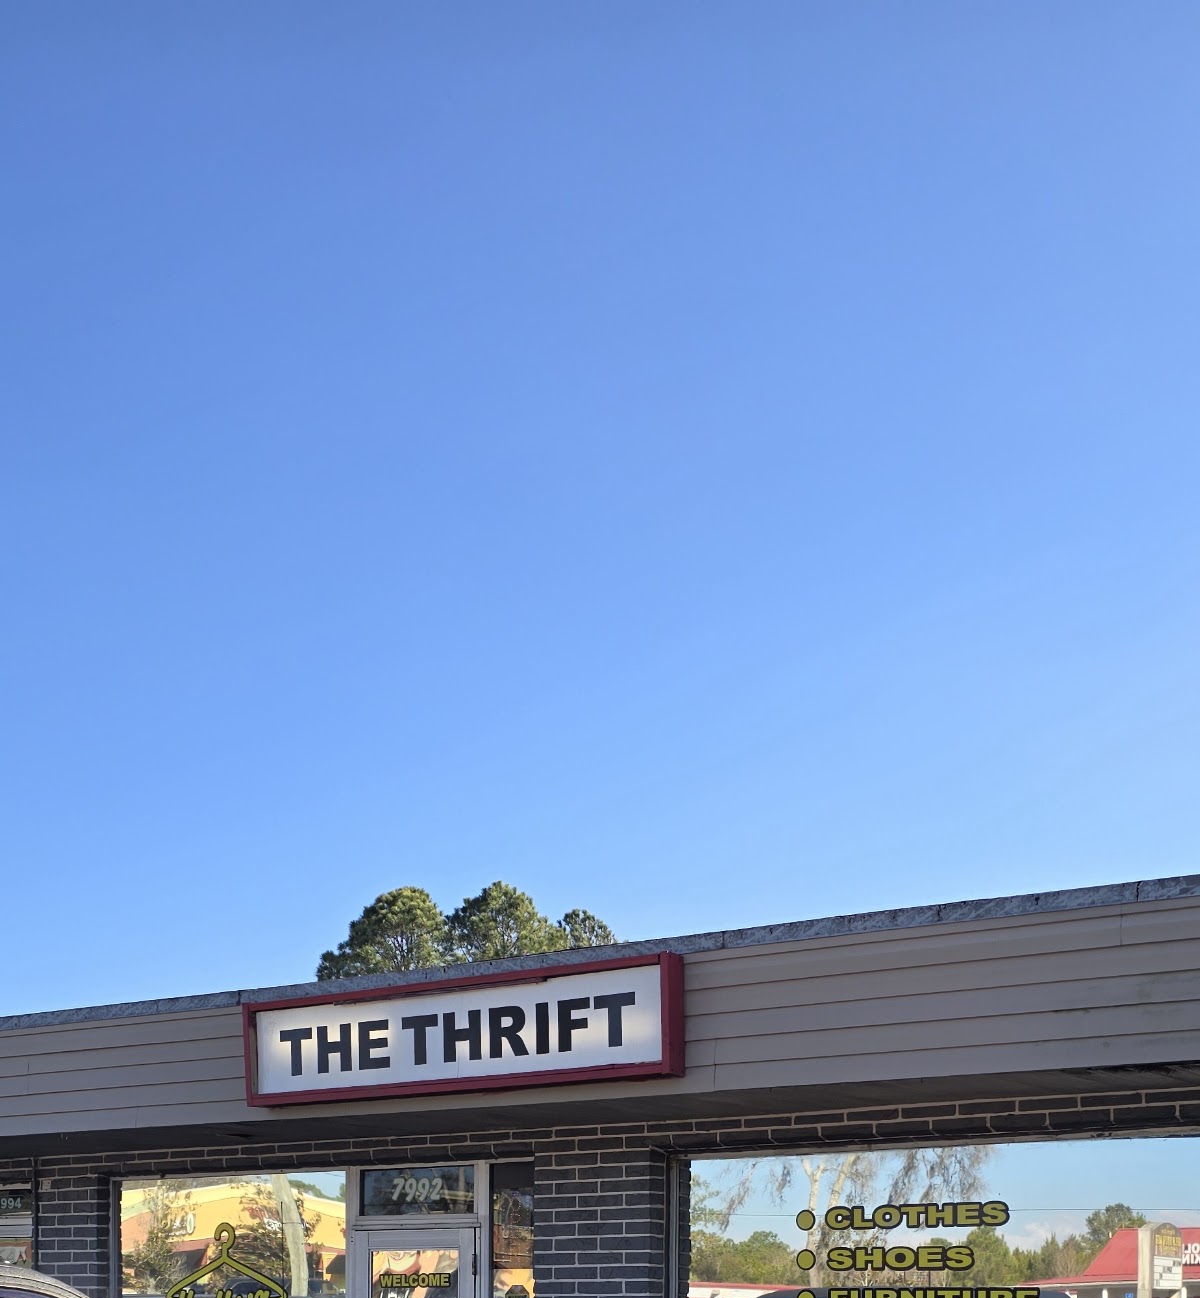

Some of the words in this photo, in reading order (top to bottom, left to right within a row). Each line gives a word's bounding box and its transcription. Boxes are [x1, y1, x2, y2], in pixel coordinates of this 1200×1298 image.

[279, 1019, 391, 1077] THE
[401, 991, 636, 1066] THRIFT
[391, 1178, 443, 1202] 7992
[0, 1197, 22, 1209] 994
[827, 1203, 1008, 1229] CLOTHES
[828, 1246, 973, 1270] SHOES
[380, 1274, 450, 1287] WELCOME
